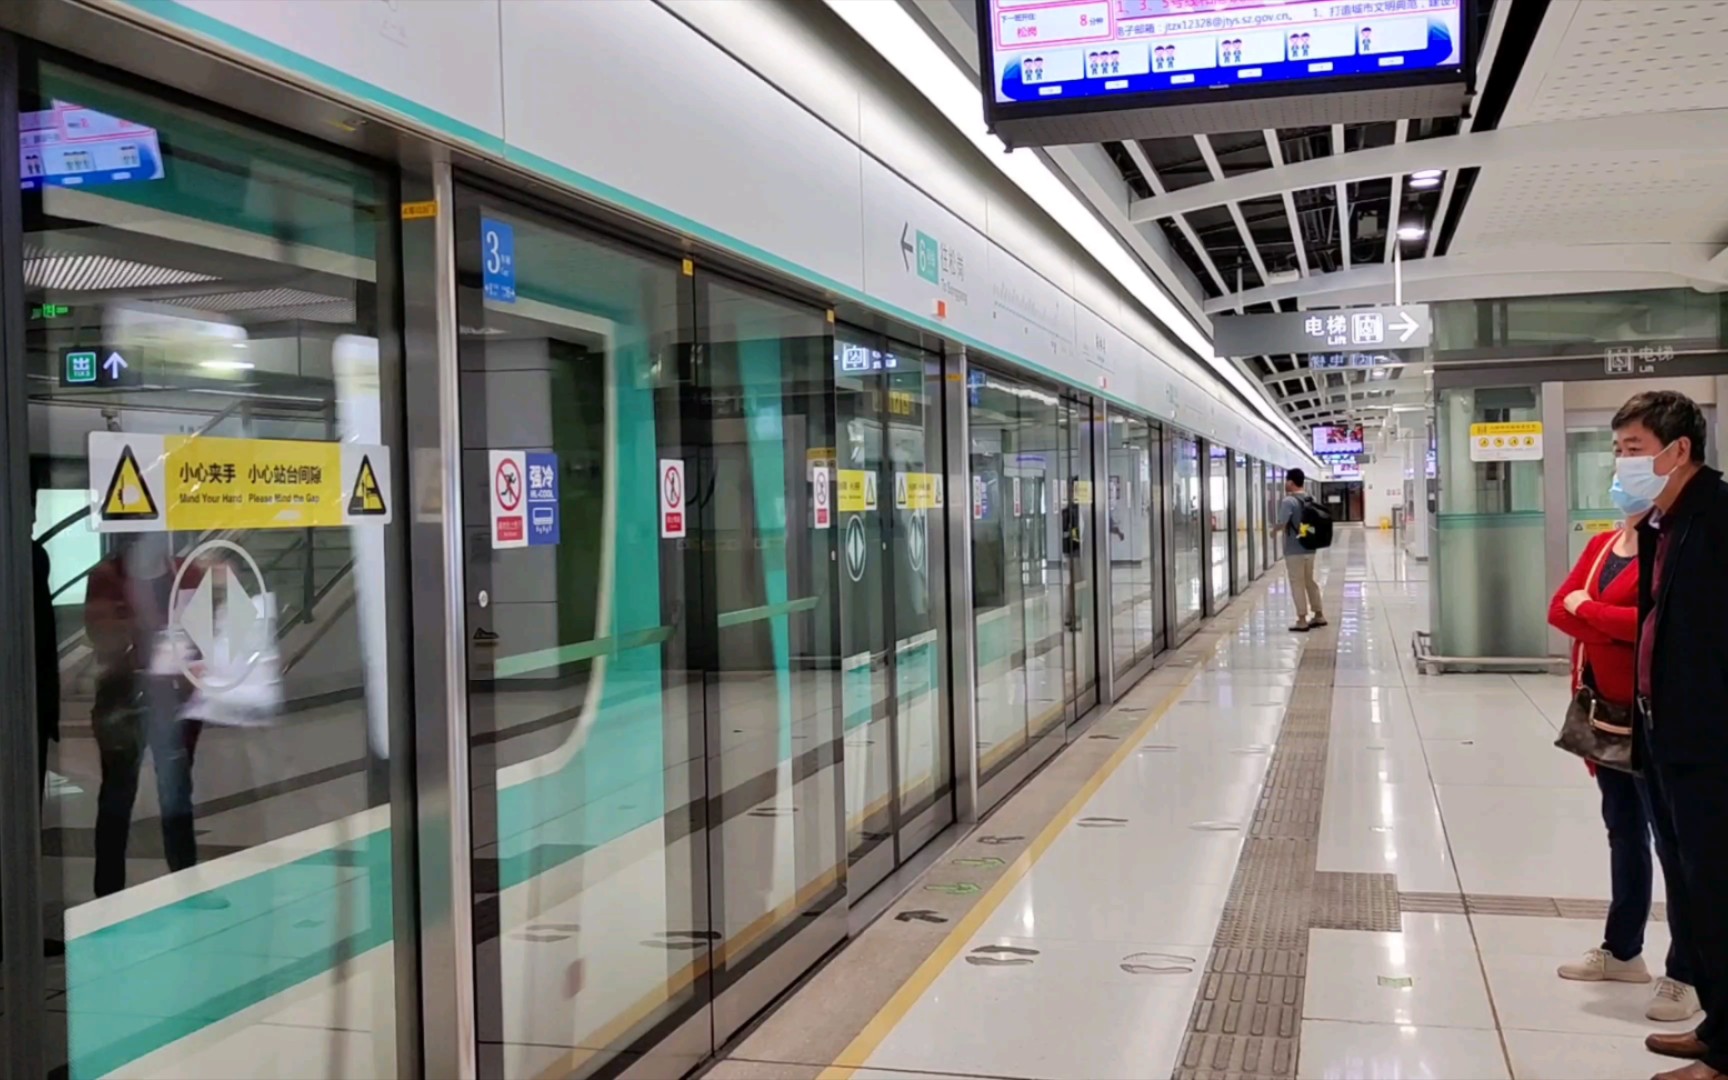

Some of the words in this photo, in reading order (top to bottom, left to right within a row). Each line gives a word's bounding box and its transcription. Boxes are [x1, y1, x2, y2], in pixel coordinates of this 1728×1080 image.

[1080, 14, 1088, 26] 8
[486, 230, 500, 274] 3
[920, 238, 927, 273] 6
[1305, 315, 1347, 336] 电梯
[1639, 345, 1674, 362] 电梯
[180, 461, 236, 483] 小心夹手
[248, 463, 322, 484] 小心站台间隙
[529, 465, 554, 488] 强冷
[180, 493, 200, 504] Mind
[202, 493, 220, 504] Your
[222, 493, 243, 504] Hand
[248, 493, 273, 503] Please
[274, 493, 292, 503] Mind
